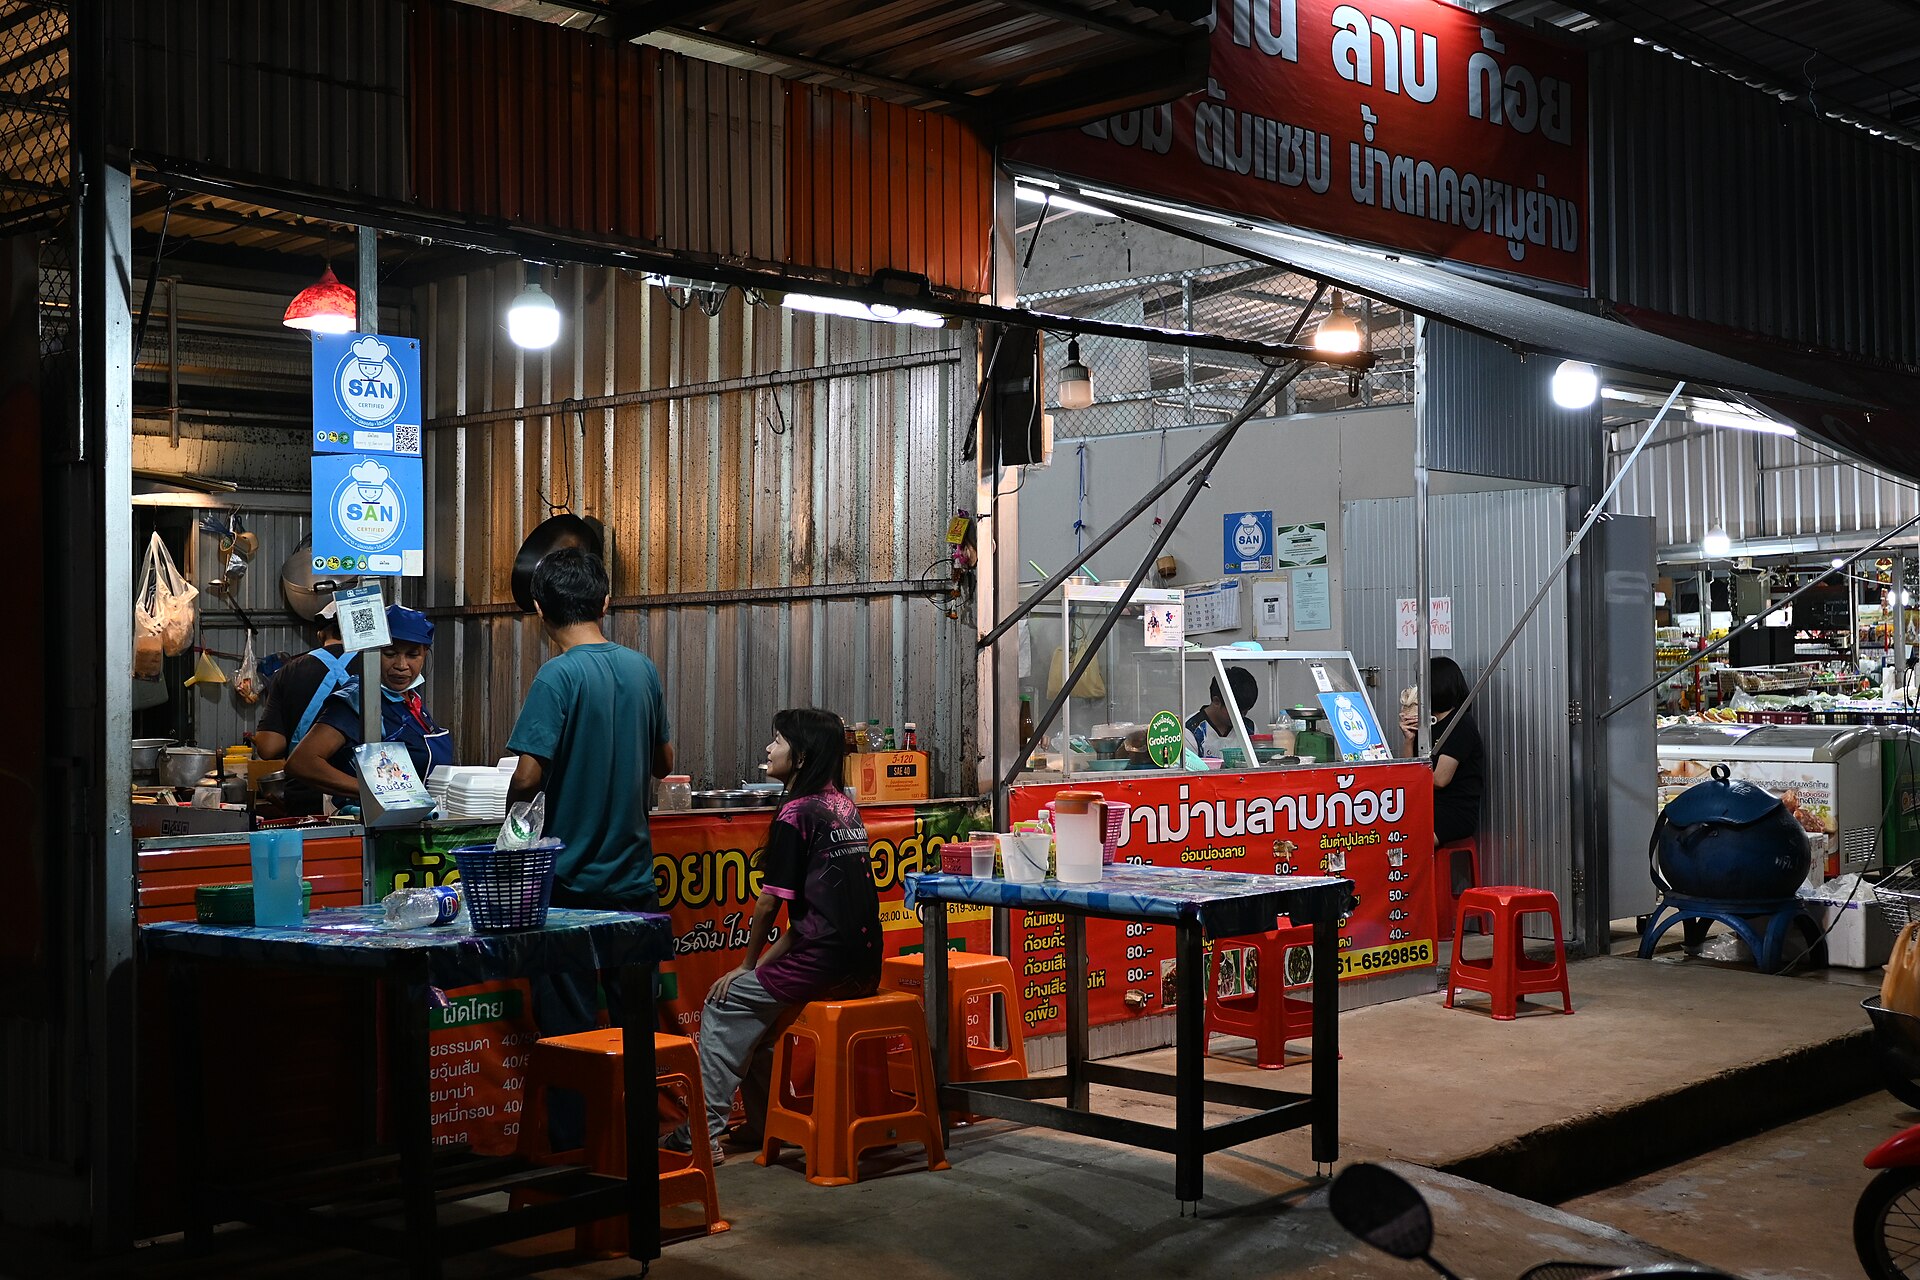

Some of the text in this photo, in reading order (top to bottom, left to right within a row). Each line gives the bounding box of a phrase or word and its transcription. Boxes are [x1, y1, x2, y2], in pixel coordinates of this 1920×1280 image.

[1192, 0, 1573, 146] าน ลาบ ก้อย
[1350, 102, 1579, 261] น้ำตกคอหมูย่าง
[348, 379, 393, 399] SAN
[358, 402, 385, 410] CERTIFIED
[346, 503, 393, 522] SAN
[1238, 535, 1260, 545] SAN
[1343, 720, 1364, 731] SAN
[1149, 732, 1181, 747] GrabFood
[1319, 830, 1408, 851] ส้มตำปูปลาร้า 40.-
[1181, 845, 1246, 863] อ่อมน่องลาย
[1388, 870, 1409, 882] 40.-
[1389, 889, 1409, 902] 50.-
[1389, 909, 1409, 921] 40.-
[1126, 922, 1153, 937] 80.-
[1389, 928, 1410, 940] 40.-
[1126, 945, 1153, 960] 80.-
[1338, 944, 1429, 975] 61-6529856
[1127, 967, 1154, 983] 80.-
[443, 997, 504, 1024] ผัดไทย
[677, 1011, 701, 1025] 50/6
[966, 1014, 979, 1025] 50
[430, 1038, 490, 1057] ยธรรมดา
[430, 1059, 480, 1082] ยวุ้นเส้น
[430, 1076, 525, 1103] ยมาม่า 40/
[430, 1099, 524, 1126] ยหมี่กรอบ 40/
[503, 1123, 520, 1136] 50
